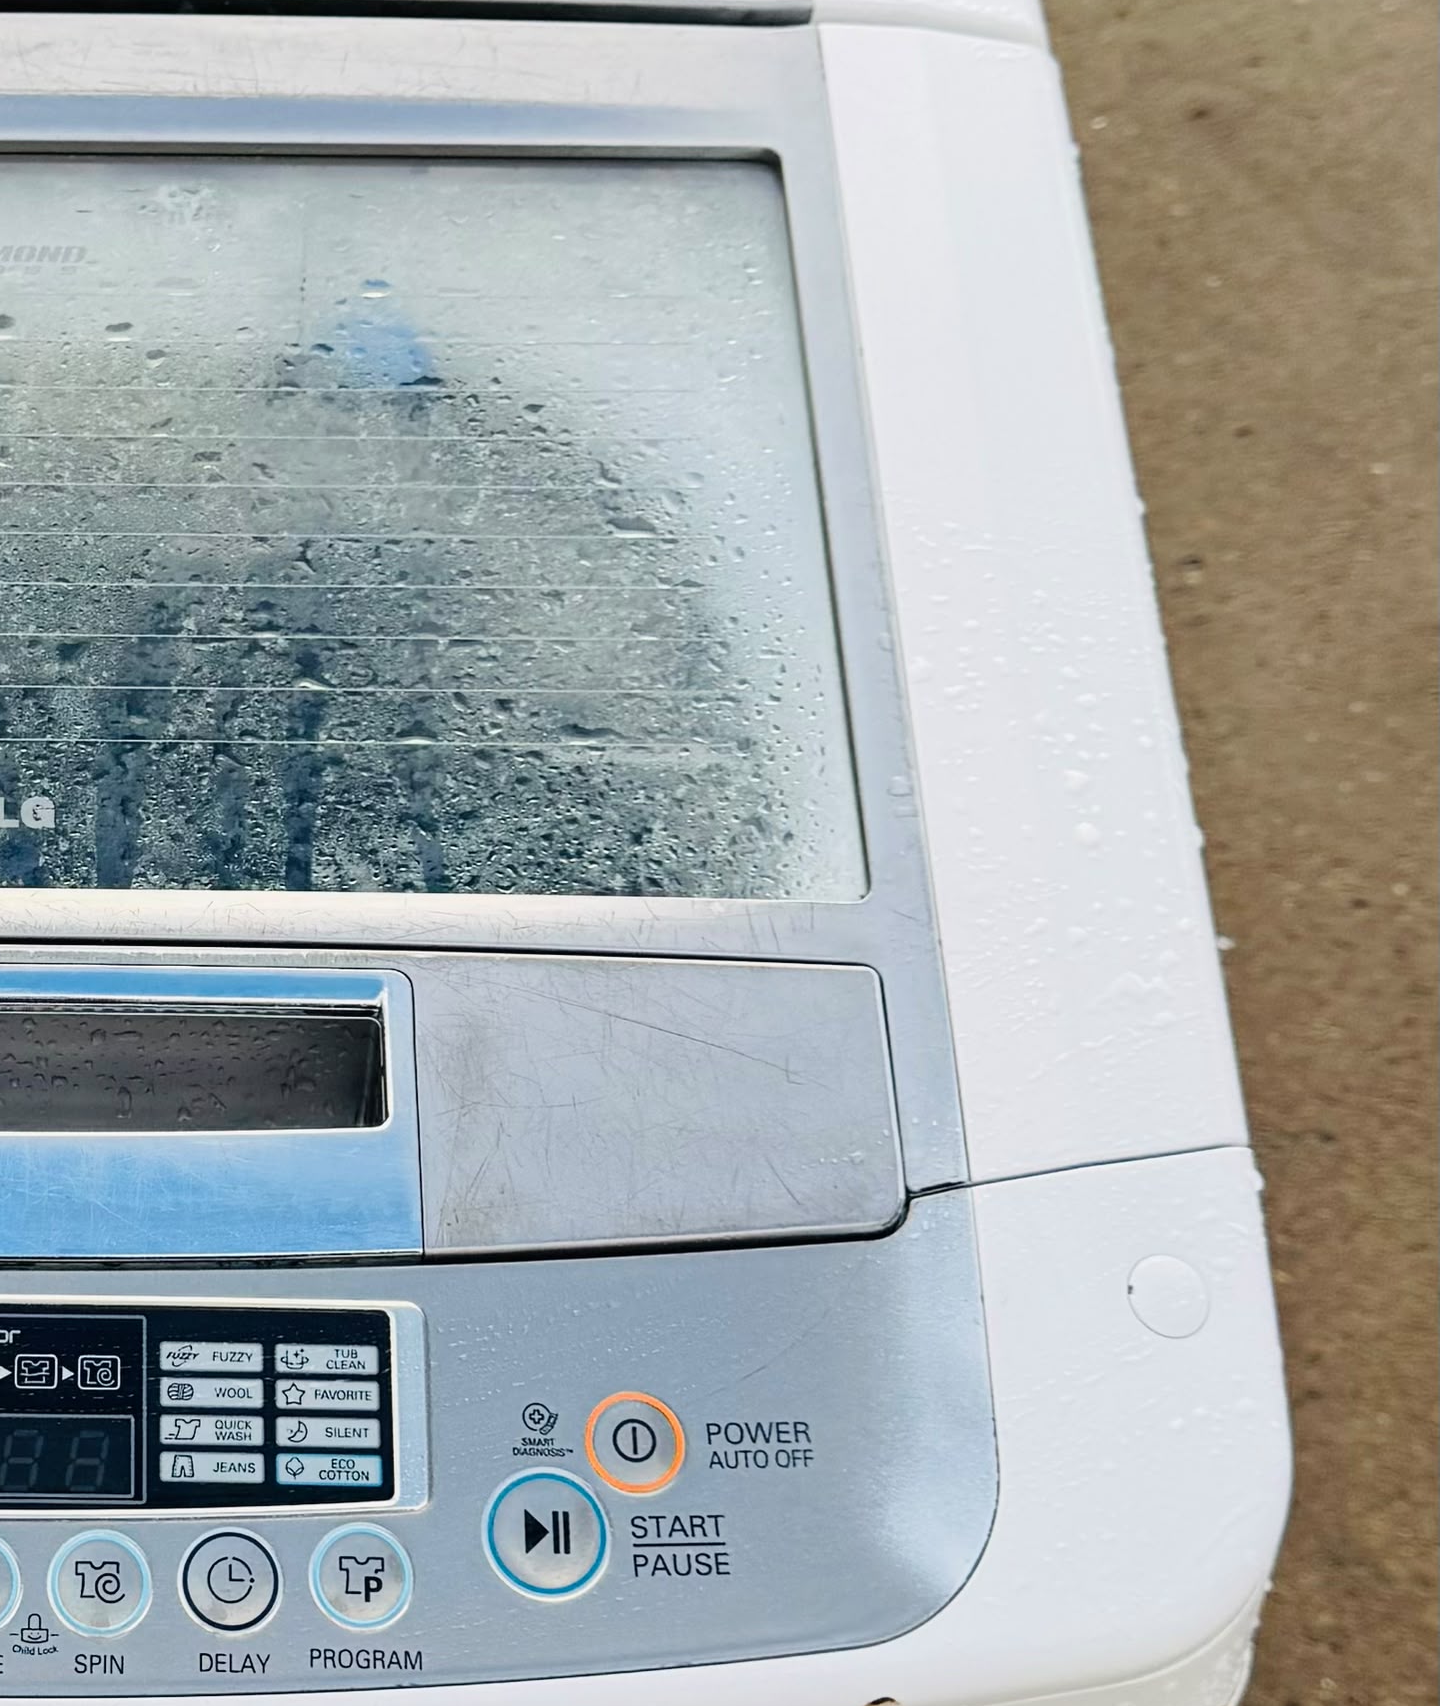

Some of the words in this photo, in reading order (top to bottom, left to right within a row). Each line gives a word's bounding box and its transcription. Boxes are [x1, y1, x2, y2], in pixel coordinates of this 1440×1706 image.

[212, 1350, 253, 1363] FUZZY
[334, 1348, 358, 1359] TUB
[326, 1359, 366, 1370] CLEAN
[214, 1387, 253, 1399] WOOL
[314, 1389, 372, 1401] FAVORITE
[214, 1419, 252, 1430] QUICK
[214, 1430, 252, 1441] WASH
[325, 1427, 369, 1439] SILENT
[705, 1421, 812, 1445] POWER
[521, 1437, 555, 1447] SMART
[331, 1458, 356, 1470] ECO
[709, 1449, 768, 1470] AUTO
[774, 1449, 815, 1469] OFF
[212, 1461, 256, 1474] JEANS
[319, 1470, 370, 1482] COTTON
[630, 1514, 725, 1539] START
[632, 1552, 731, 1577] PAUSE
[12, 1644, 36, 1656] Child
[37, 1644, 59, 1656] Lock
[74, 1654, 126, 1675] SPIN
[198, 1652, 271, 1675] DELAY
[308, 1647, 424, 1672] PROGRAM
